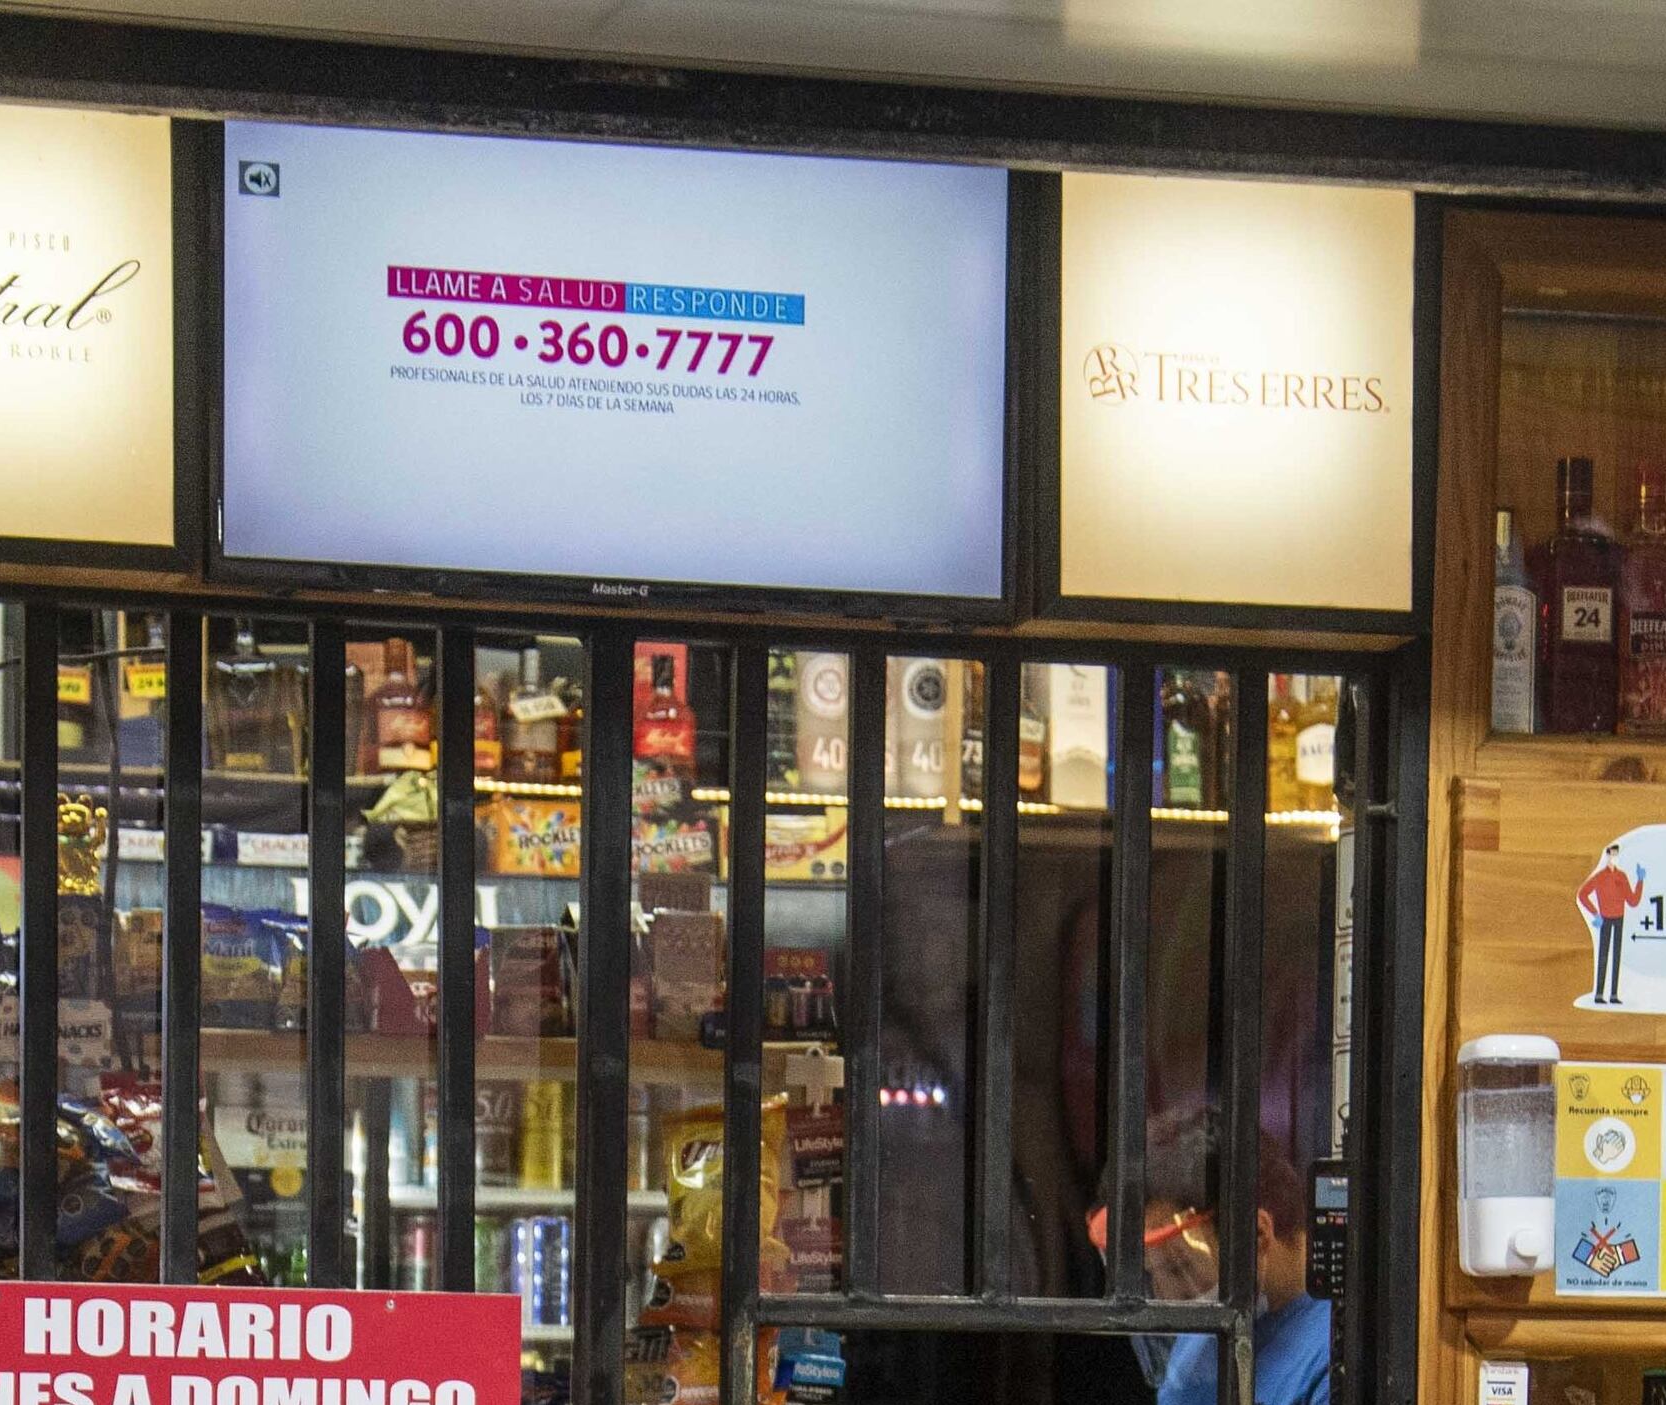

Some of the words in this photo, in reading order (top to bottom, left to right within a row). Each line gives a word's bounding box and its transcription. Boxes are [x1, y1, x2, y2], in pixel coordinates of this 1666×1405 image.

[395, 268, 481, 299] LLAME
[490, 277, 508, 300] A
[519, 279, 617, 308] SALUD
[632, 287, 788, 320] RESPONDE
[10, 342, 94, 364] ROBLE
[390, 366, 487, 386] PROFESIONALES
[490, 372, 506, 386] DE
[509, 374, 525, 388] LA
[527, 375, 565, 391] SALUD
[568, 377, 644, 395] ATENDIENDO
[647, 382, 670, 397] SUS
[673, 383, 713, 399] DUDAS
[716, 385, 738, 400] LAS
[740, 388, 756, 402] 24
[520, 391, 543, 406] LOS
[546, 393, 554, 406] 7
[587, 396, 602, 410] DE
[606, 397, 621, 411] LA
[623, 398, 675, 415] SEMANA
[1573, 607, 1601, 628] 24
[812, 736, 846, 771] 40
[911, 738, 944, 772] 40
[1568, 1105, 1611, 1116] Recuerda
[1613, 1108, 1649, 1118] siempre
[1566, 1278, 1579, 1287] NO
[23, 1296, 353, 1362] HORARIO
[1491, 1387, 1513, 1396] VISA
